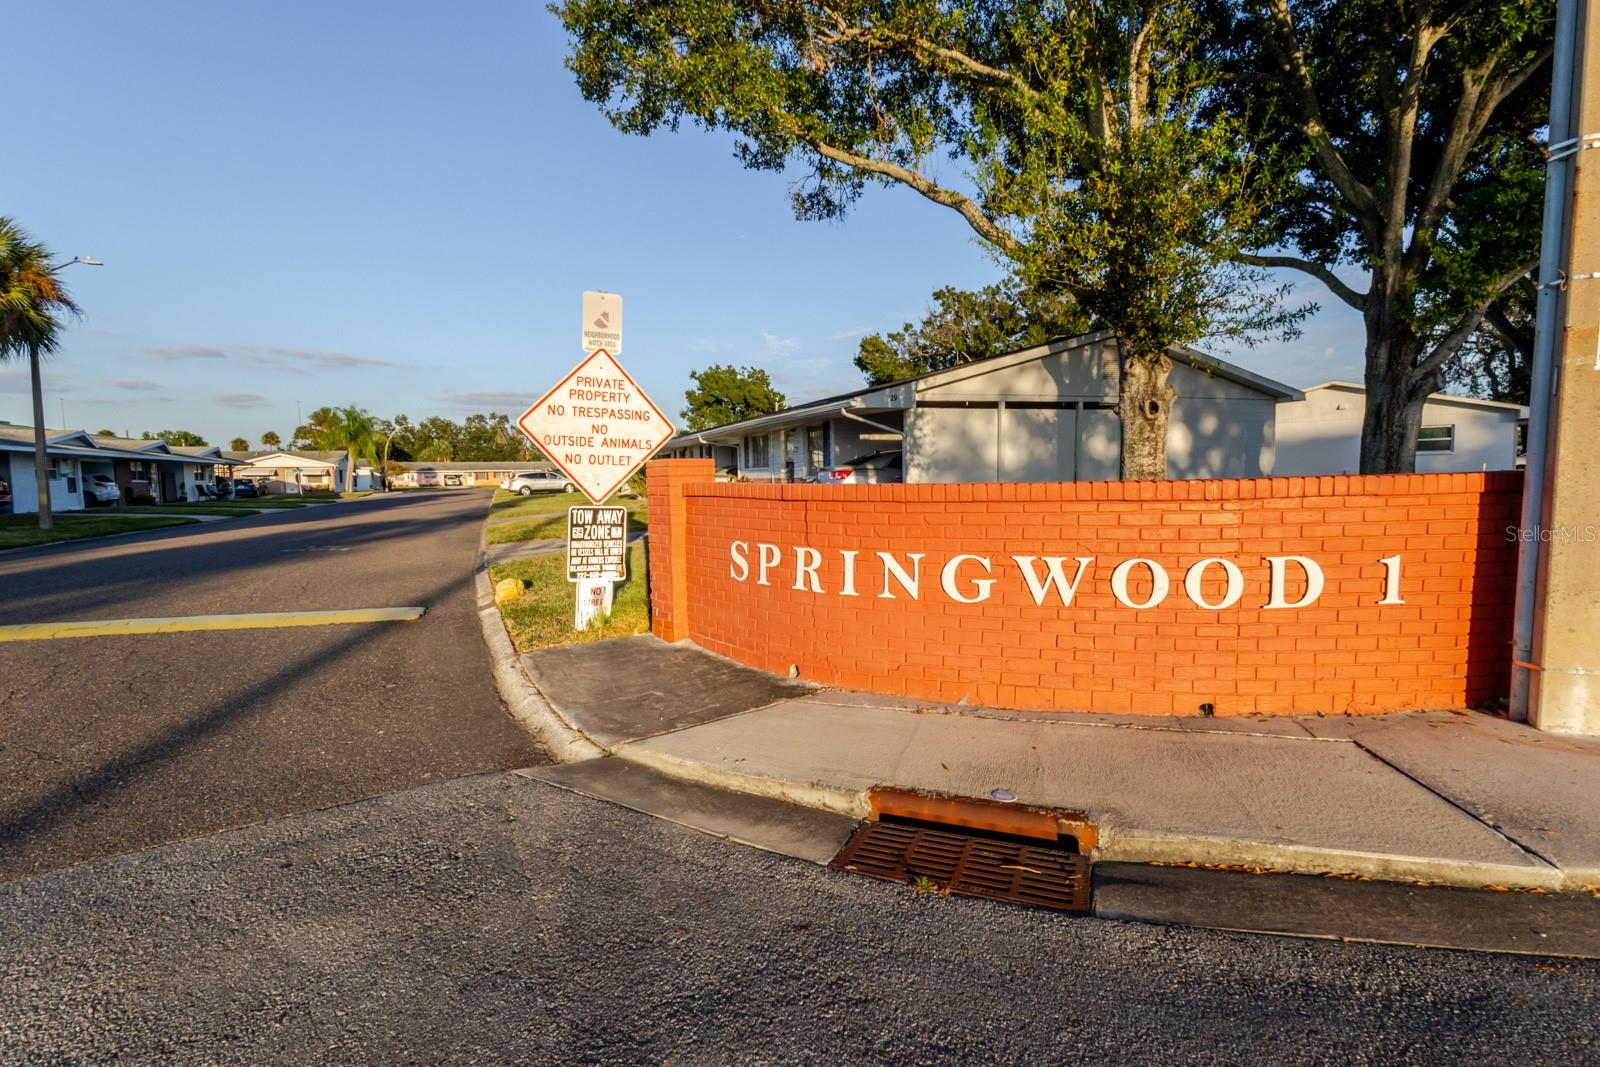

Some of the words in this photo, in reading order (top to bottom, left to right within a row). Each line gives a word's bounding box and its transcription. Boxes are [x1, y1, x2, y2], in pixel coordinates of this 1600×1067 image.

[576, 376, 625, 390] PRIVATE
[569, 389, 631, 403] PROPERTY
[547, 404, 565, 416] NO
[572, 406, 650, 421] TRESPASSING
[591, 424, 608, 435] NO
[543, 434, 594, 448] OUTSIDE
[601, 437, 652, 450] ANIMALS
[565, 453, 582, 465] NO
[588, 455, 632, 466] OUTLET
[572, 509, 593, 524] TOW
[596, 509, 624, 524] AWAY
[584, 525, 611, 539] ZONE
[729, 540, 1325, 611] SPRINGWOOD
[1377, 554, 1405, 605] 1
[590, 586, 602, 596] NO
